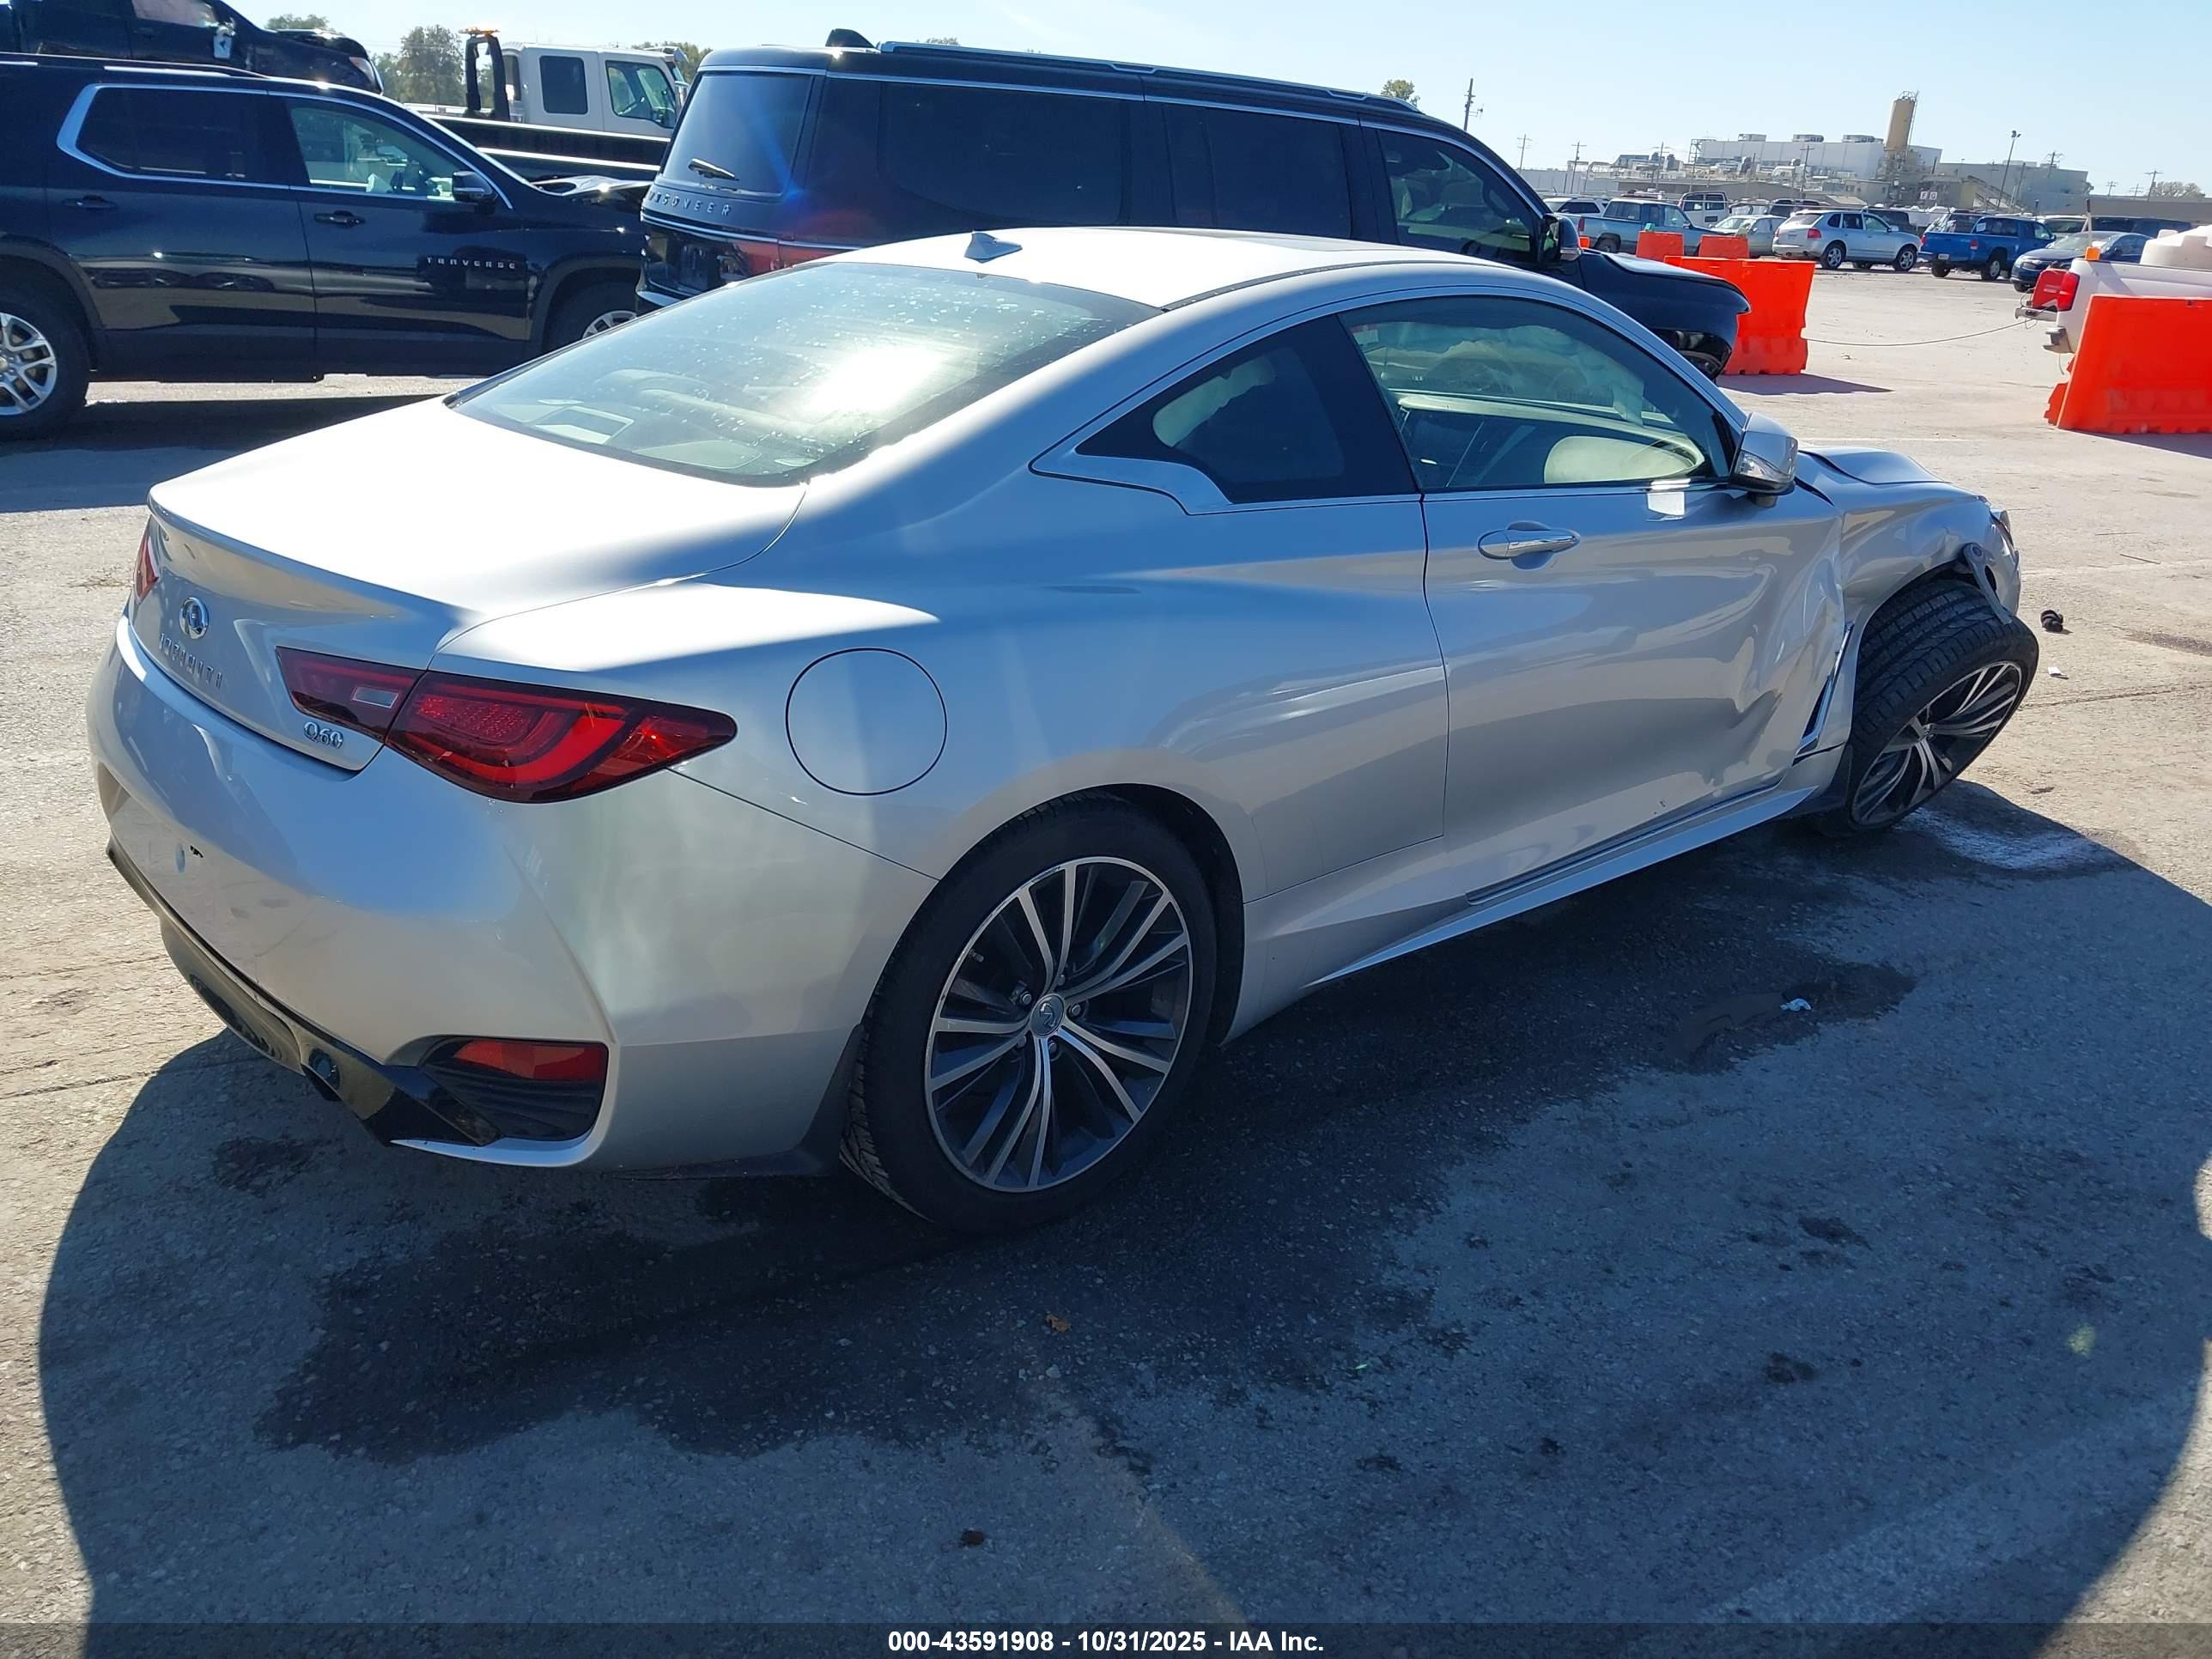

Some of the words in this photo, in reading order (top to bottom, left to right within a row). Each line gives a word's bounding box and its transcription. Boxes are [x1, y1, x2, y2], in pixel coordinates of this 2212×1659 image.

[427, 257, 515, 270] TRAVERSE
[158, 633, 223, 689] INFINITI
[304, 721, 343, 749] Q60
